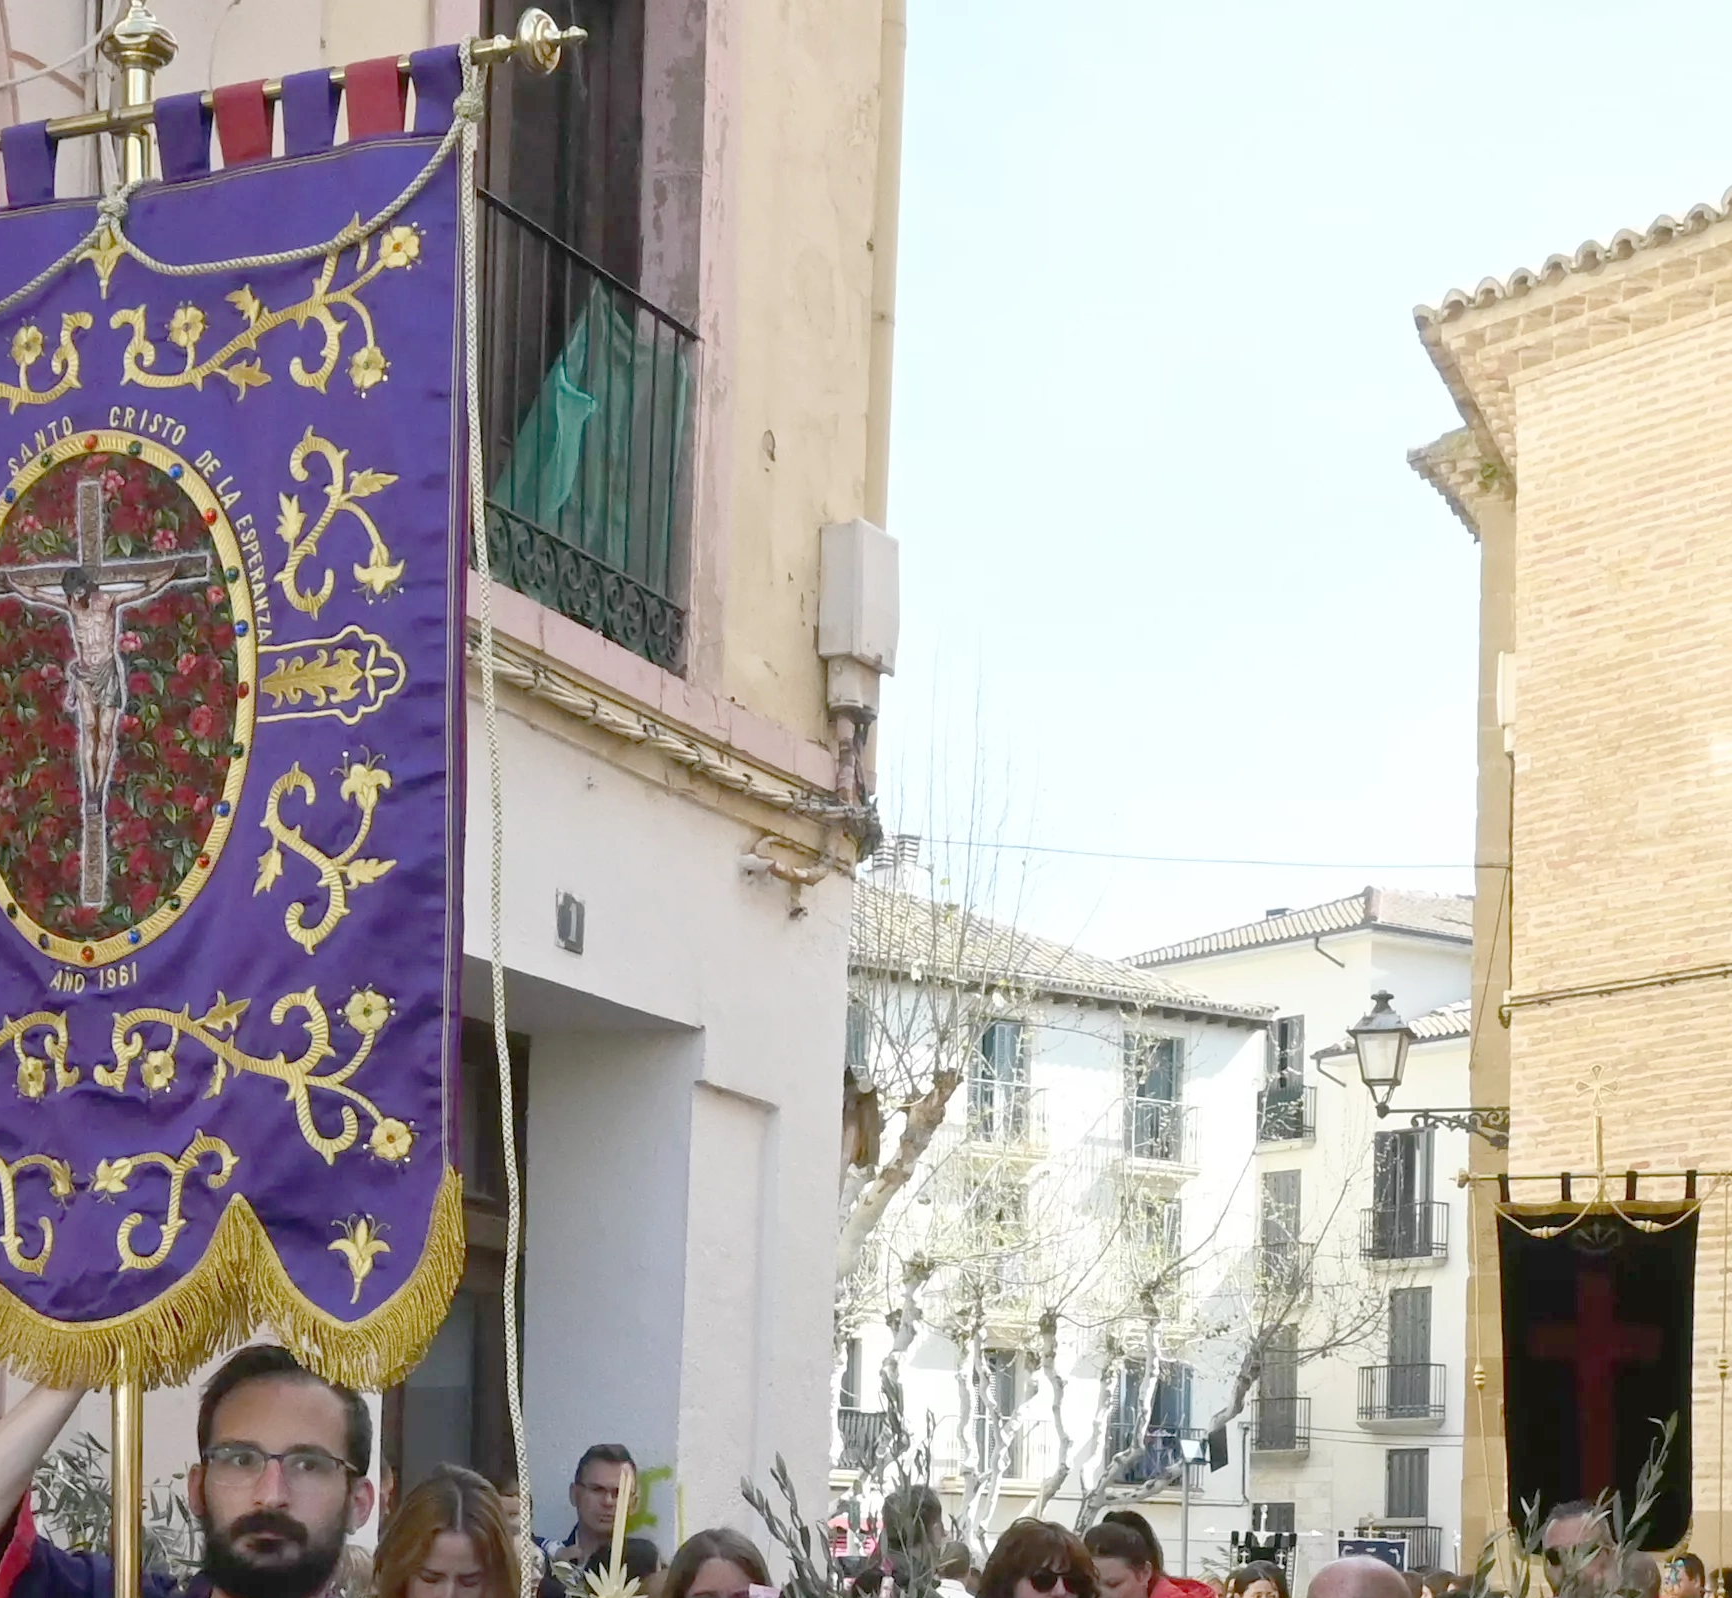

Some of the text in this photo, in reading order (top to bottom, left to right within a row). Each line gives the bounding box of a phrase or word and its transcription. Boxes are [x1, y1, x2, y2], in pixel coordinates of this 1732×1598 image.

[7, 415, 74, 477] SANTO
[109, 405, 187, 446] CRISTO
[194, 449, 221, 479] DE
[215, 475, 242, 510] LA
[235, 513, 273, 643] ESPERANZA
[49, 961, 137, 994] AÑO 1961
